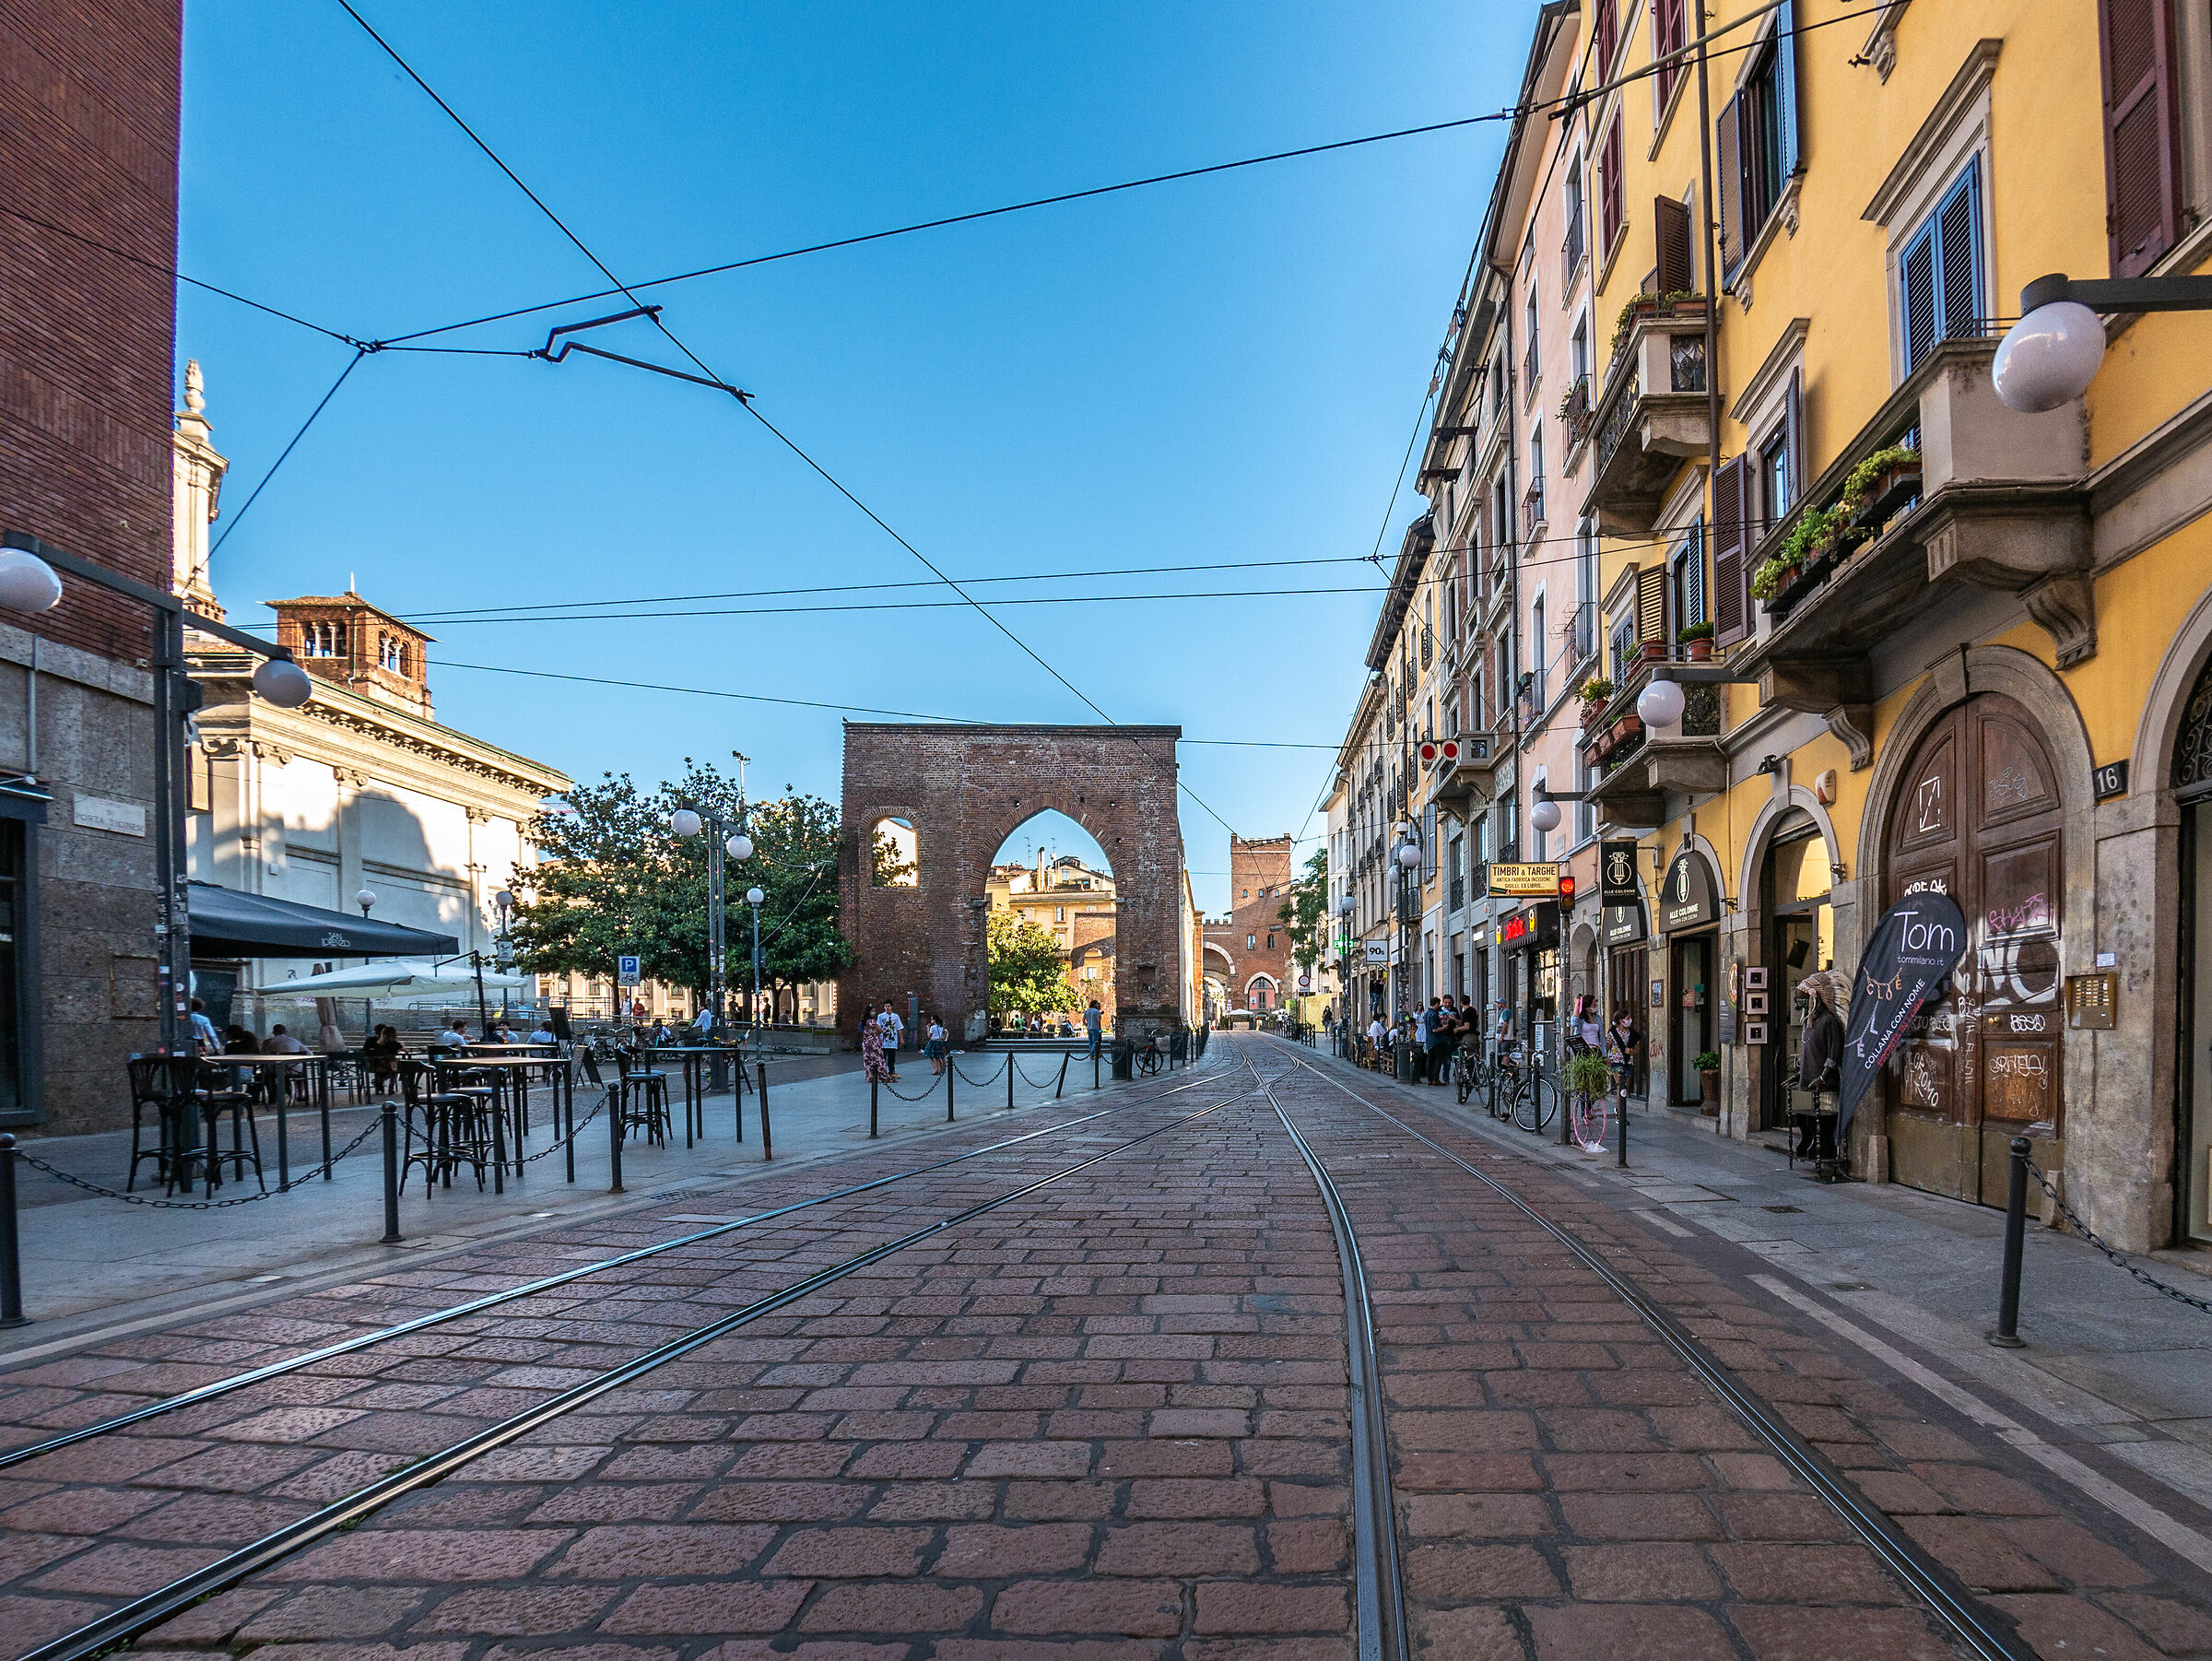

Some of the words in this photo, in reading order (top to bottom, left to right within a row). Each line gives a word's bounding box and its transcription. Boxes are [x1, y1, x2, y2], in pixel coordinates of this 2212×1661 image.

[2098, 768, 2117, 793] 16
[76, 812, 104, 824] PORTA
[1492, 866, 1519, 876] TIMBRI
[1527, 866, 1556, 875] TARGHE
[1669, 909, 1678, 920] ALLE
[1678, 902, 1699, 917] COLONNE
[1894, 911, 1954, 952] Tom
[1369, 947, 1384, 955] 90s
[625, 959, 634, 971] P
[1865, 1030, 1893, 1069] COLLANA
[1890, 1007, 1906, 1030] CON
[1903, 978, 1926, 1008] NOME
[1877, 1032, 1901, 1067] PRONTA
[1899, 1023, 1909, 1033] IN
